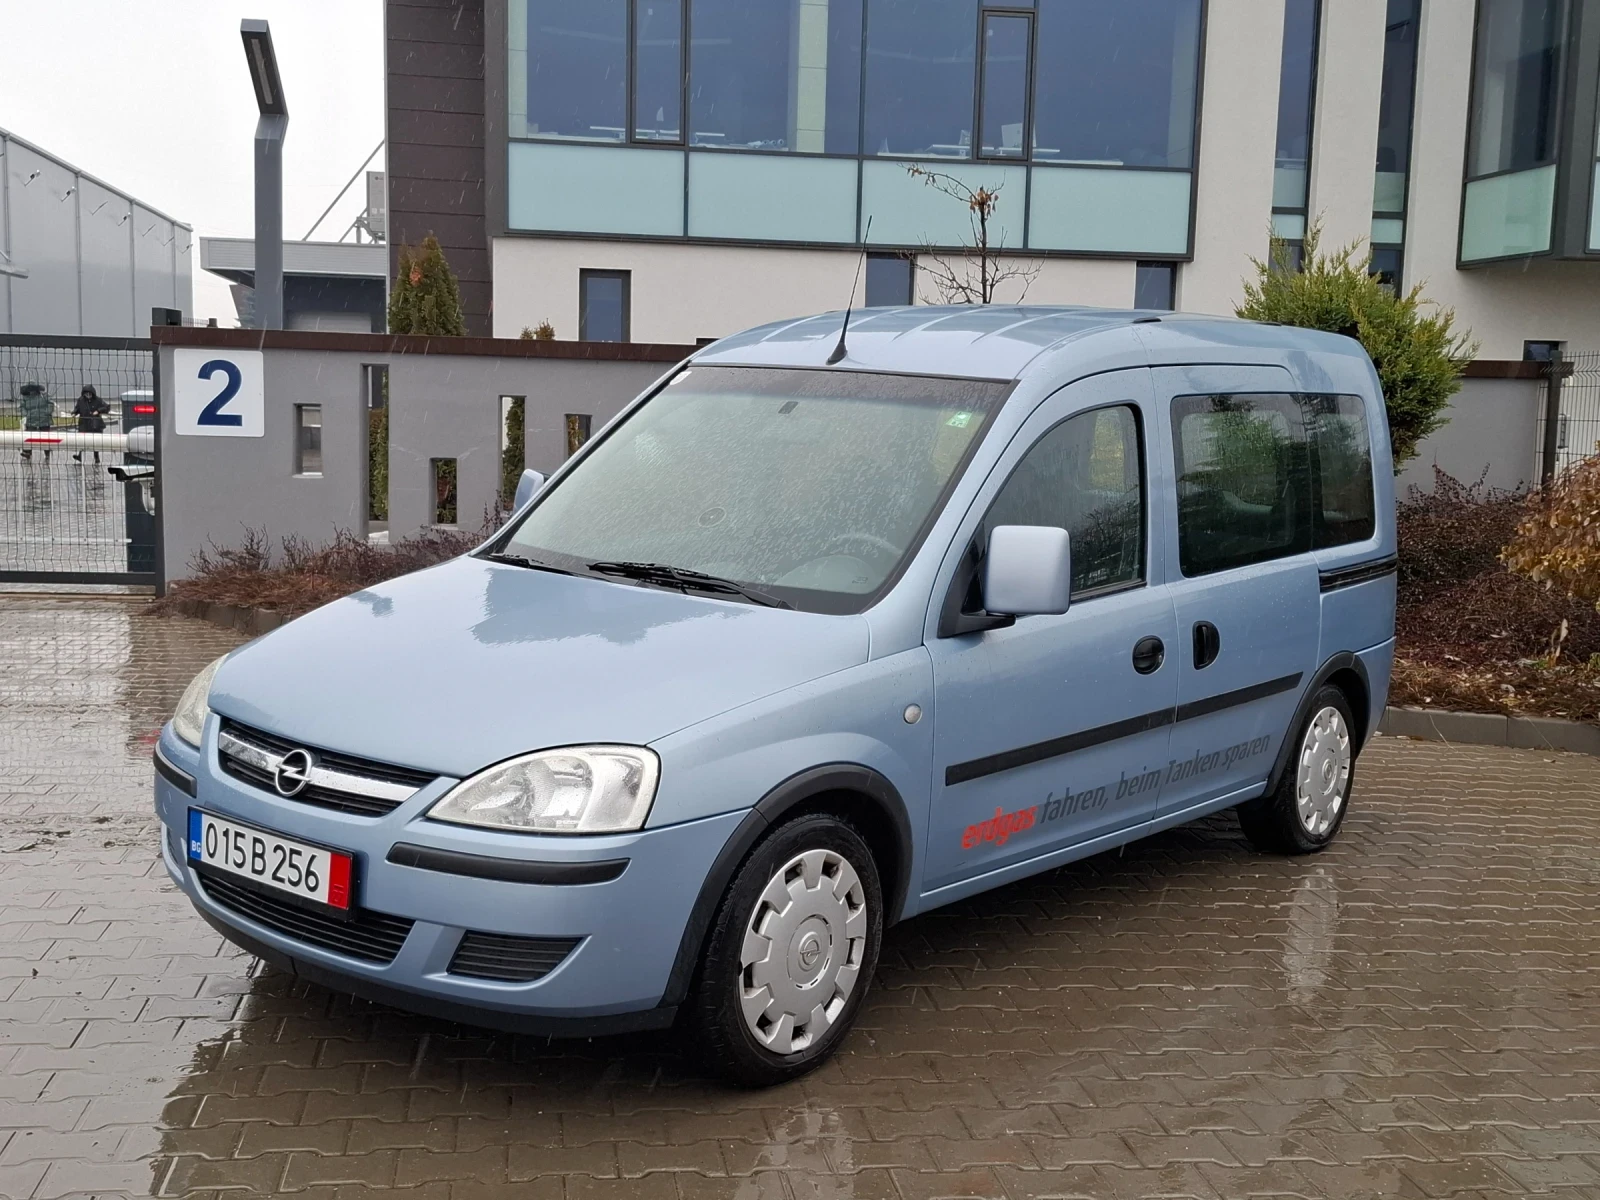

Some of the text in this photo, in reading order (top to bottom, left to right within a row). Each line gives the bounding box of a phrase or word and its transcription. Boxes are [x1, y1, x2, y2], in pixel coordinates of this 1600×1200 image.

[197, 359, 243, 427] 2
[961, 734, 1271, 849] erdgas fahren, beim Tanken sparen
[191, 839, 201, 853] BG
